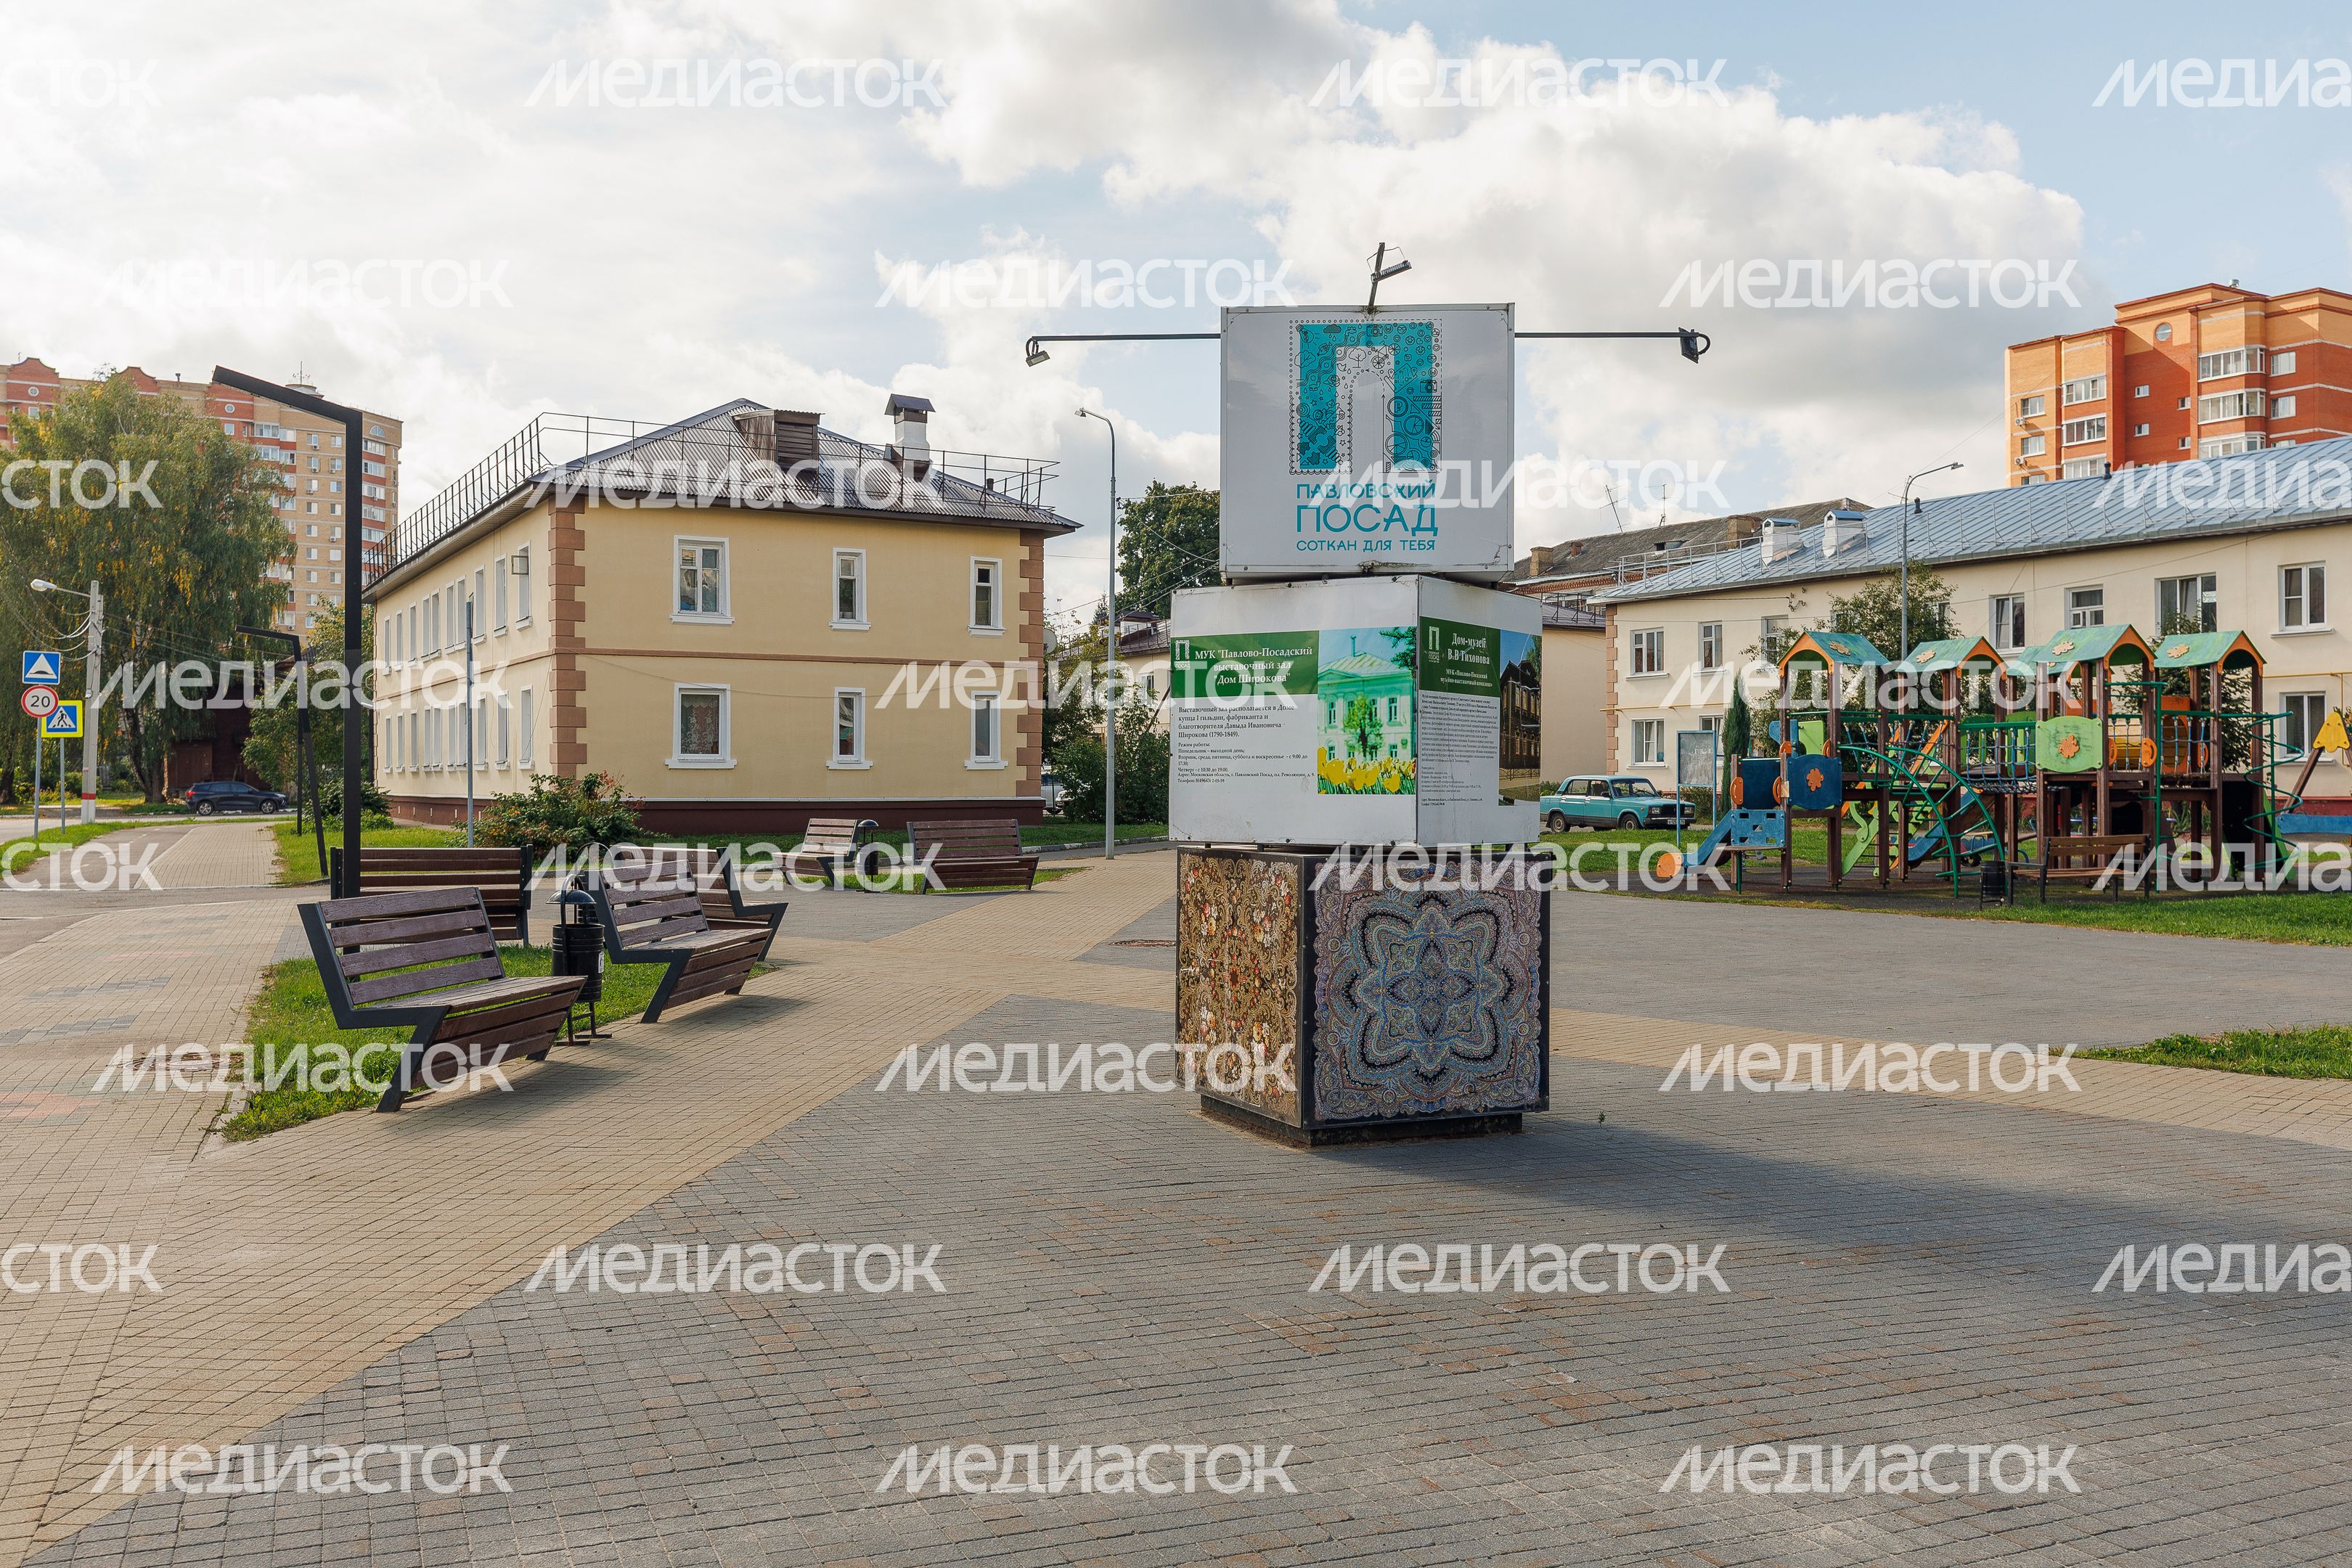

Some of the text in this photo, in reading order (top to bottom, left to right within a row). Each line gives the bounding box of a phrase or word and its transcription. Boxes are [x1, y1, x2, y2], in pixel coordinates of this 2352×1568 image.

[1296, 479, 1436, 499] ПАВЛОВСКИЙ
[1296, 505, 1438, 536] ПОСАД
[1296, 539, 1436, 552] СОТКАН ДЛЯ ТЕБЯ
[1451, 632, 1487, 650] Дом-музей
[1195, 646, 1312, 660] МУК "Павлово-Посадский
[1461, 650, 1490, 665] Тихонова
[1214, 661, 1274, 671] выставочный
[1214, 672, 1291, 685] "Дом Широкова"
[30, 695, 50, 708] 20
